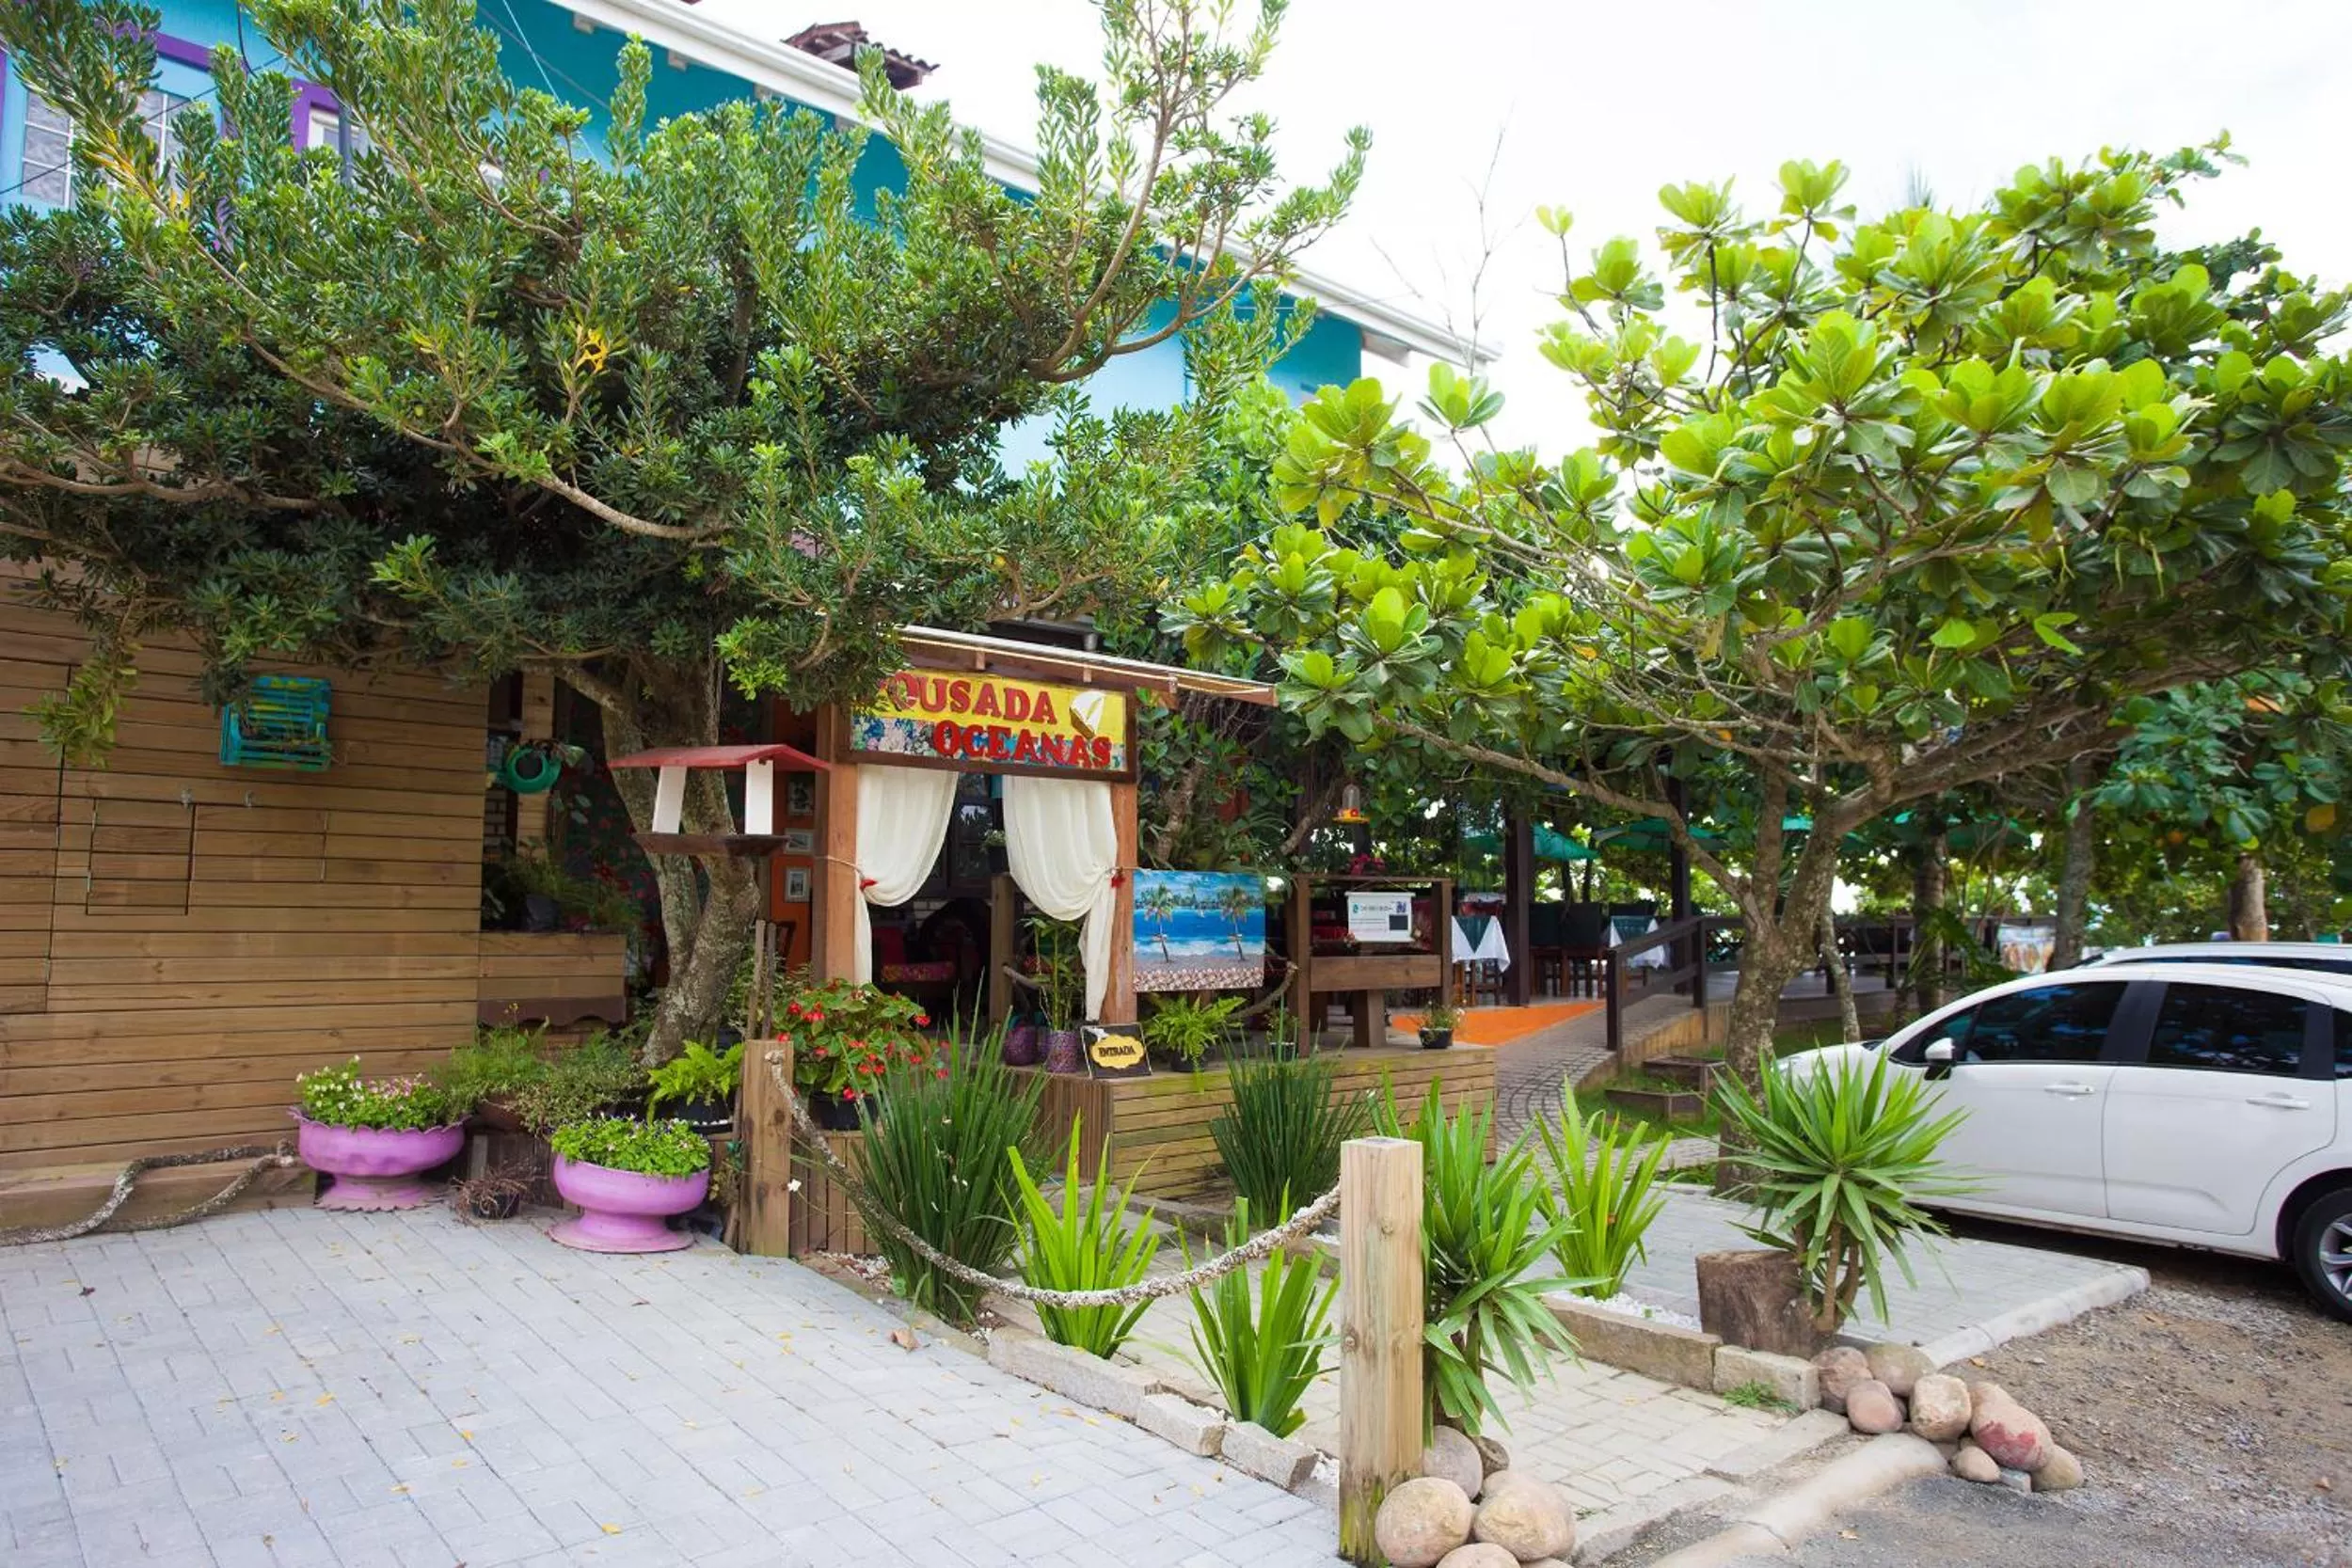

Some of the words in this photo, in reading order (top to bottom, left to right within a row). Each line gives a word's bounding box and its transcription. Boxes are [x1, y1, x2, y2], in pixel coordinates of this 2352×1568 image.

[876, 669, 1057, 725] OUSADA
[932, 719, 1113, 768] OCEANAS
[1098, 1045, 1136, 1057] ENTRADA
